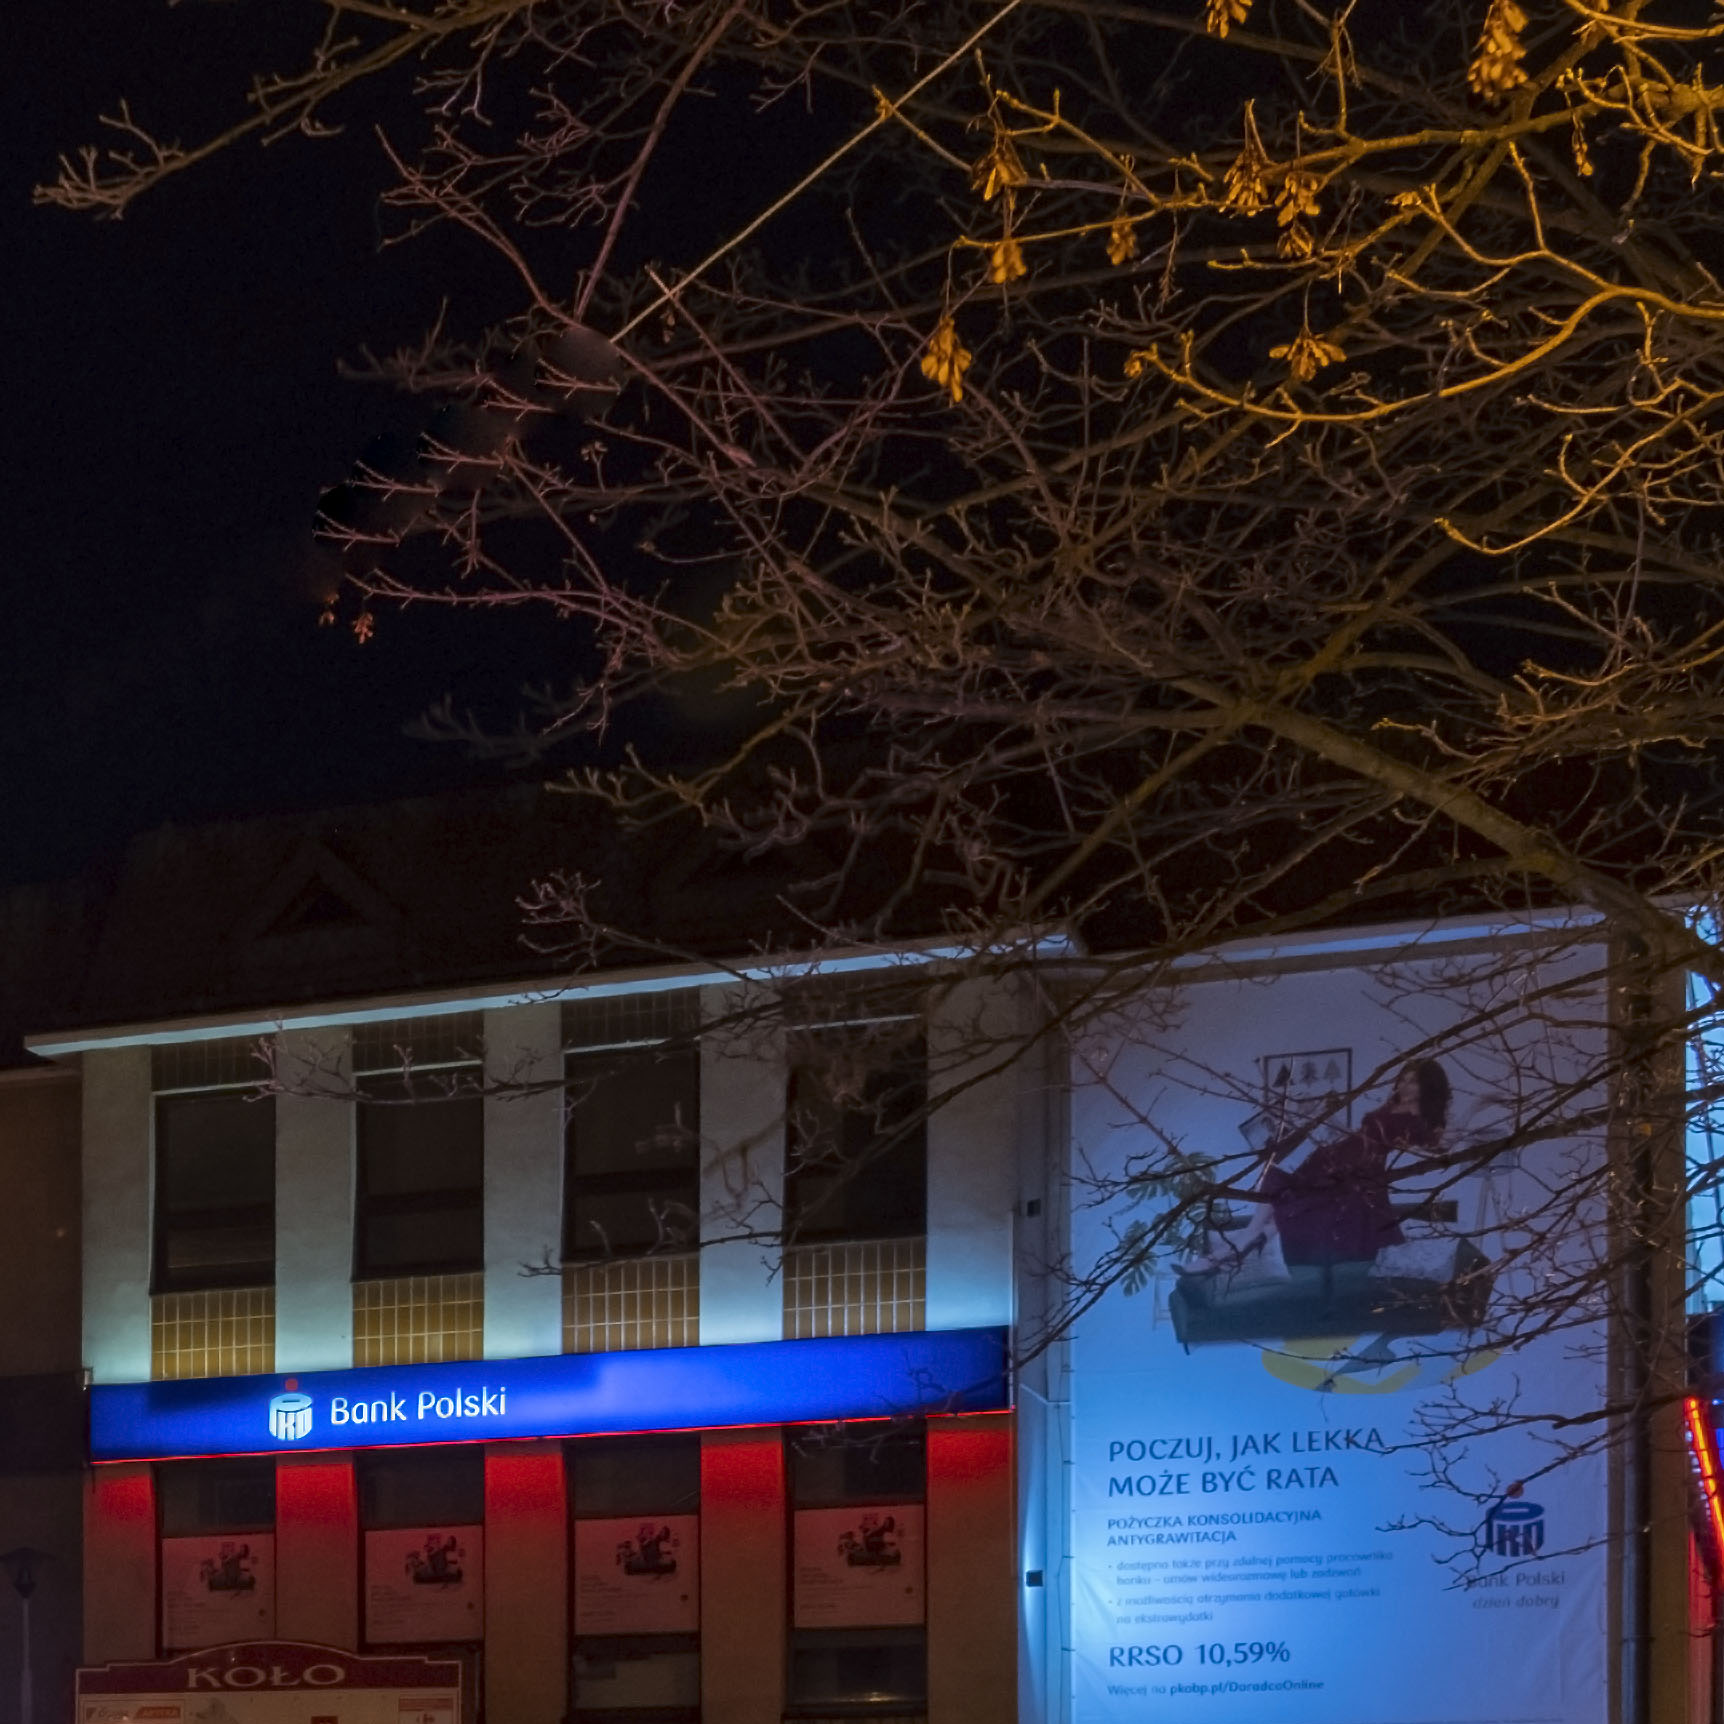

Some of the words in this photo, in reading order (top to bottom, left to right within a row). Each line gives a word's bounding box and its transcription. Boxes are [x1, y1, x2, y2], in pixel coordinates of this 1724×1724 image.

[331, 1391, 406, 1425] Bank
[418, 1386, 506, 1420] Polski
[1108, 1436, 1221, 1463] POCZUJ,
[1230, 1432, 1281, 1462] JAK
[1292, 1427, 1384, 1453] LEKKA
[1108, 1469, 1190, 1497] MOŻE
[1202, 1465, 1256, 1494] BYĆ
[1266, 1466, 1339, 1490] RATA
[1107, 1514, 1182, 1529] POŻYCZKA
[1187, 1509, 1322, 1526] KONSOLIDACYJNA
[1107, 1530, 1237, 1546] ANTYGRAWITACJA
[1516, 1571, 1566, 1586] Polski
[1109, 1645, 1183, 1667] RRSO
[1197, 1640, 1292, 1668] 10,59%
[187, 1665, 346, 1688] KOŁO
